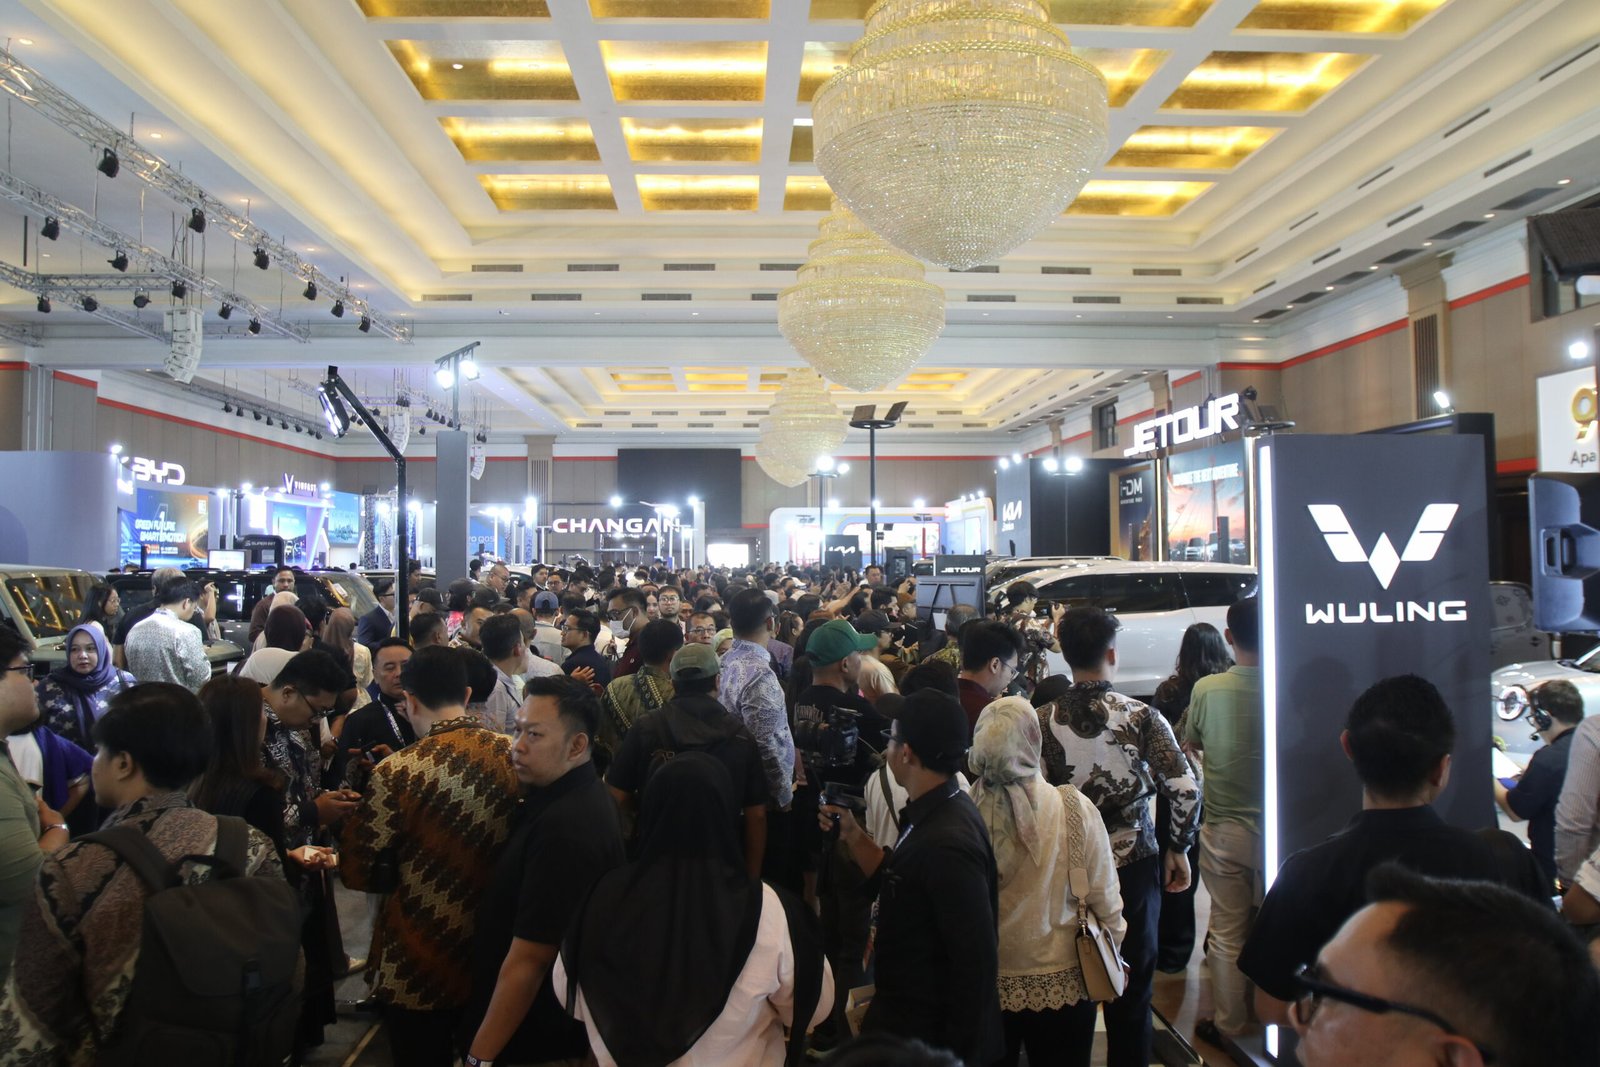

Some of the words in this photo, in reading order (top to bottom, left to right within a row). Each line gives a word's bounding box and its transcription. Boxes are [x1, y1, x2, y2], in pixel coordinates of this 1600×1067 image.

[1123, 393, 1240, 457] JETOUR
[132, 456, 186, 486] BYD
[552, 518, 681, 533] CHANGAN
[1305, 601, 1468, 624] WULING
